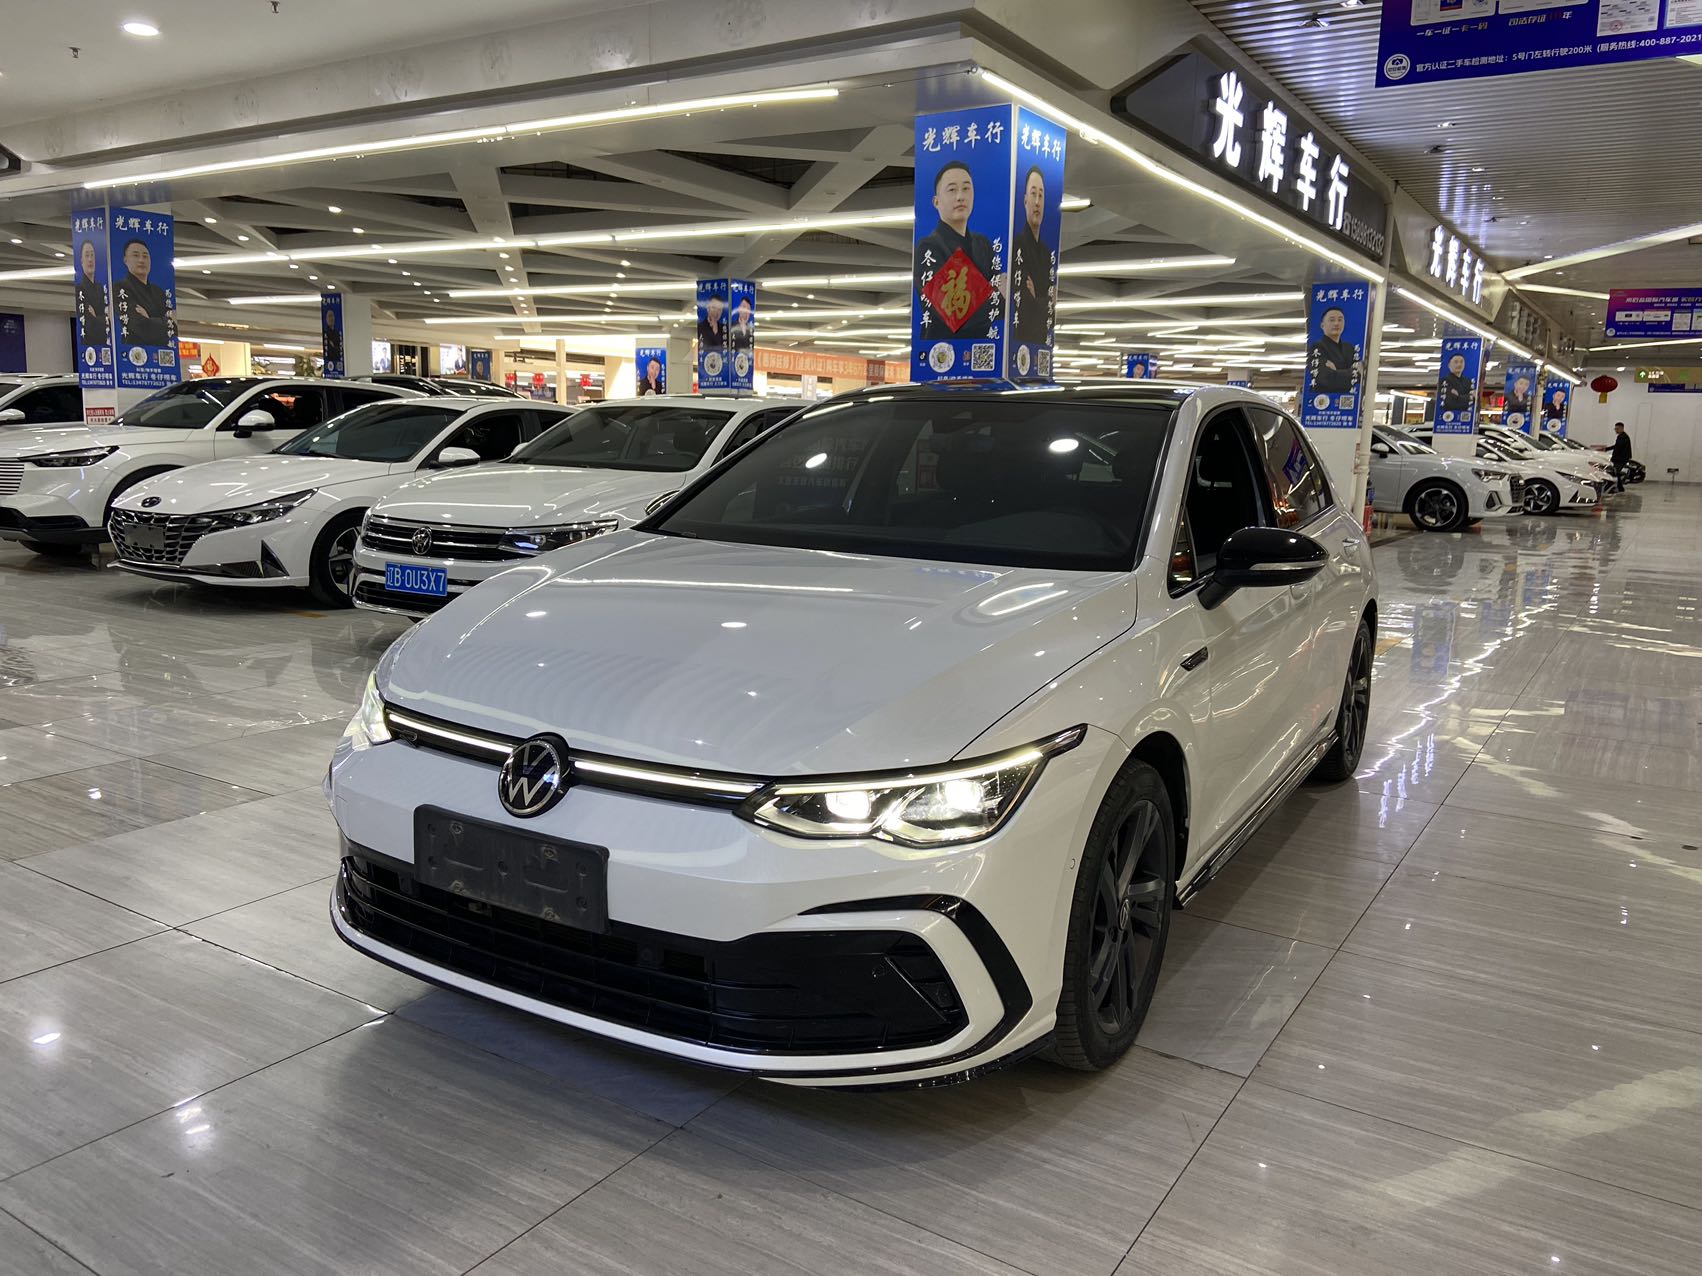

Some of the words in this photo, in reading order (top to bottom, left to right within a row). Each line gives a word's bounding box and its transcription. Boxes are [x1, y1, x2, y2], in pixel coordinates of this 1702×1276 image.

[923, 121, 1004, 152] 光辉车行
[1021, 123, 1061, 161] 光辉车行
[1213, 71, 1349, 230] 光辉车行
[75, 217, 104, 232] 光辉车行
[115, 215, 169, 236] 光辉车行
[1430, 225, 1485, 305] 光辉车行
[940, 266, 971, 321] 福
[986, 237, 1003, 340] 为您保驾护航
[1315, 288, 1364, 302] 光辉车行
